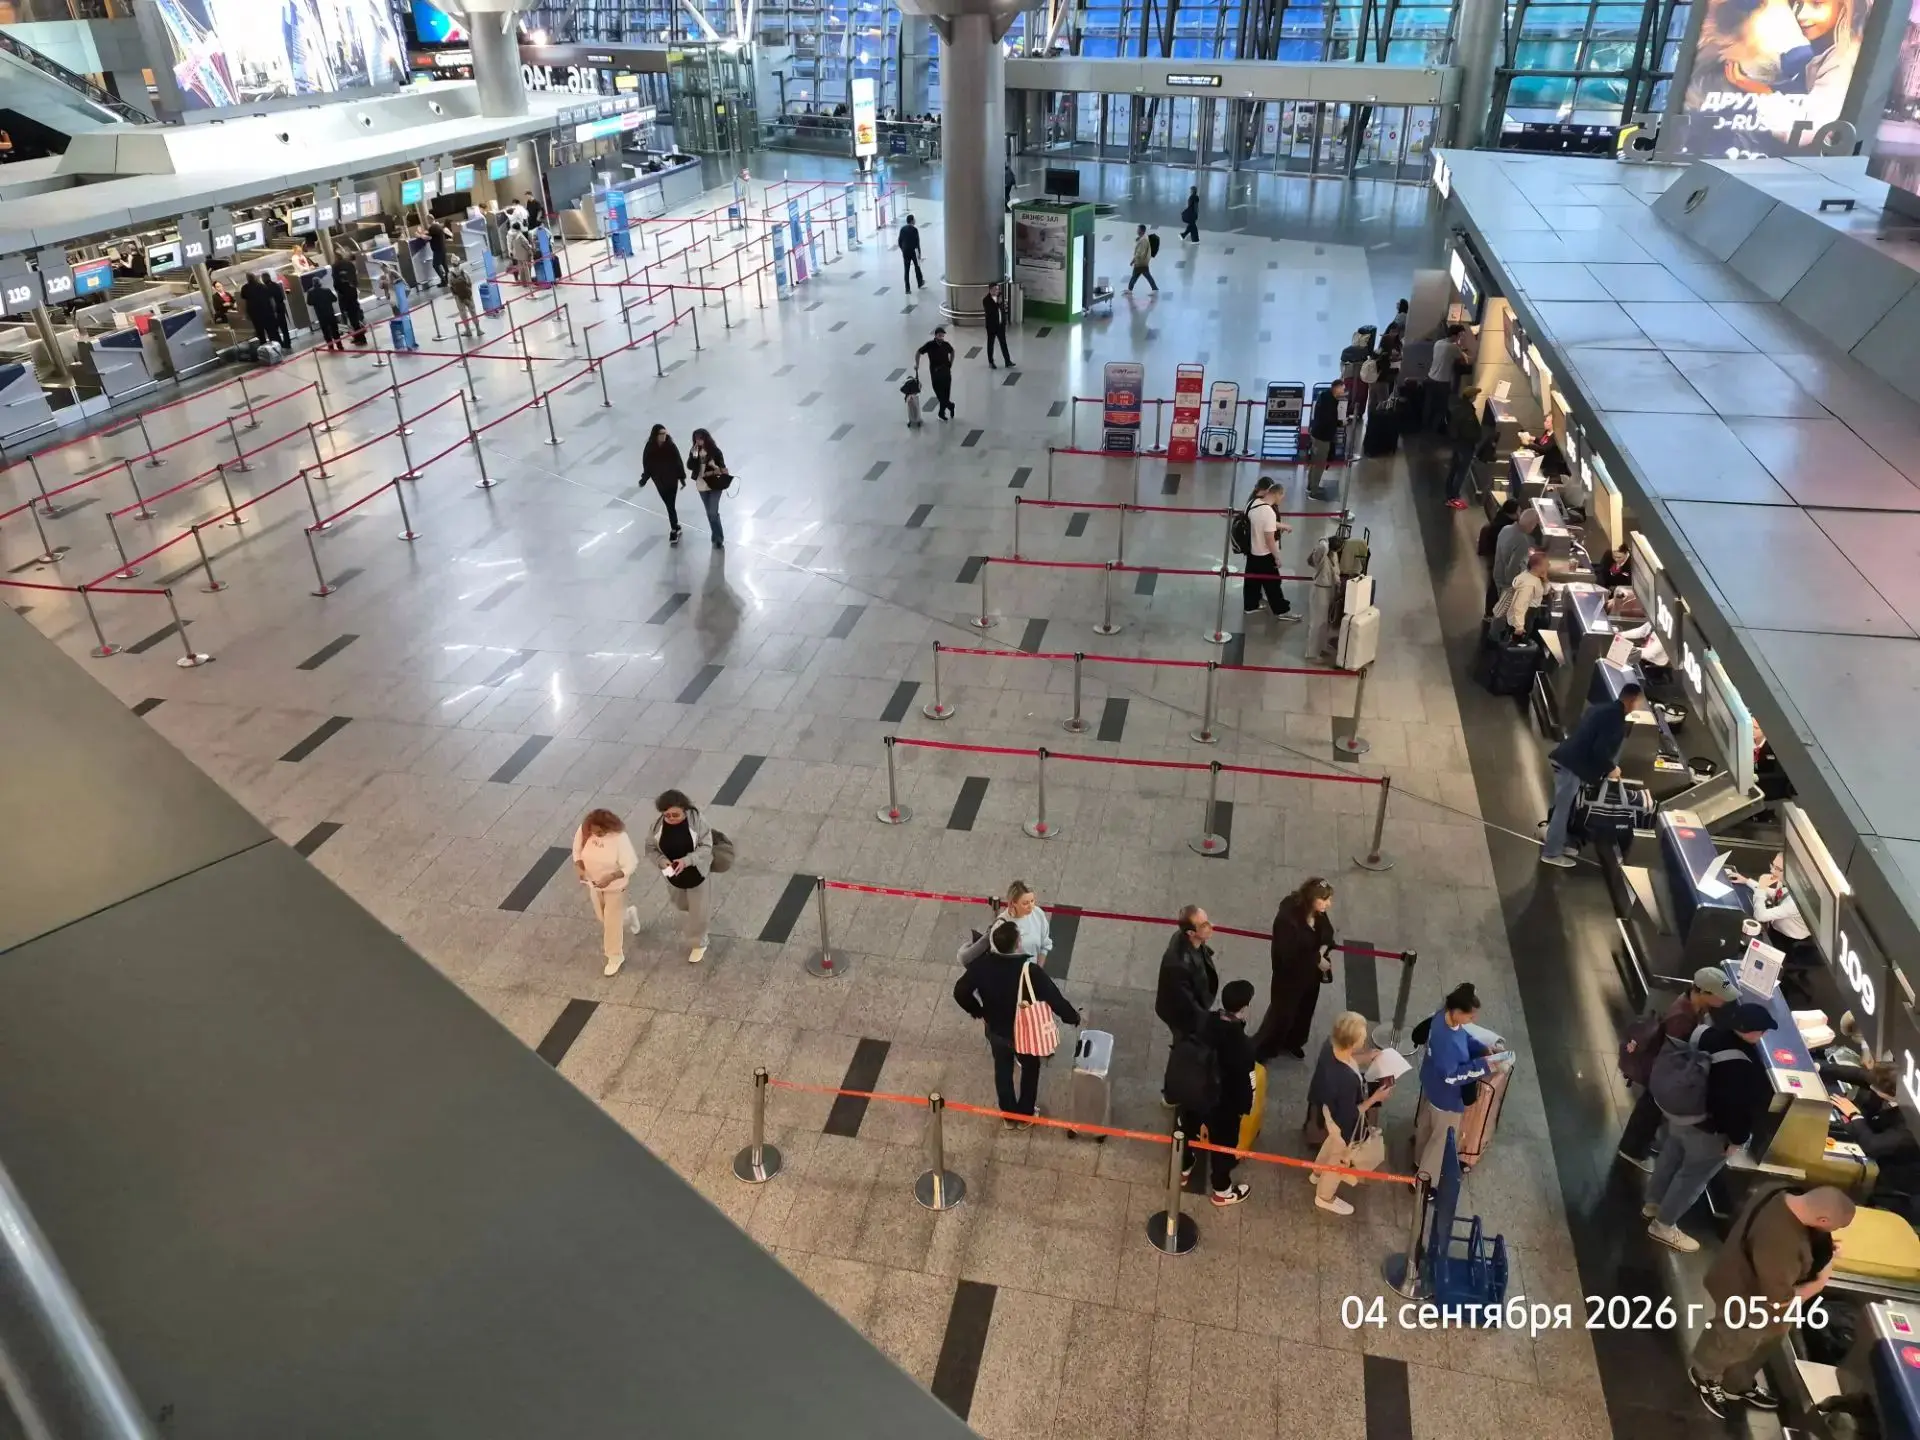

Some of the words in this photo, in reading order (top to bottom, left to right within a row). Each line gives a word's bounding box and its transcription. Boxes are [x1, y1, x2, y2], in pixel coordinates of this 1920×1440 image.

[184, 241, 204, 258] 121
[215, 234, 234, 250] 122
[47, 275, 71, 294] 120
[7, 285, 31, 304] 119
[1839, 930, 1876, 1016] 109
